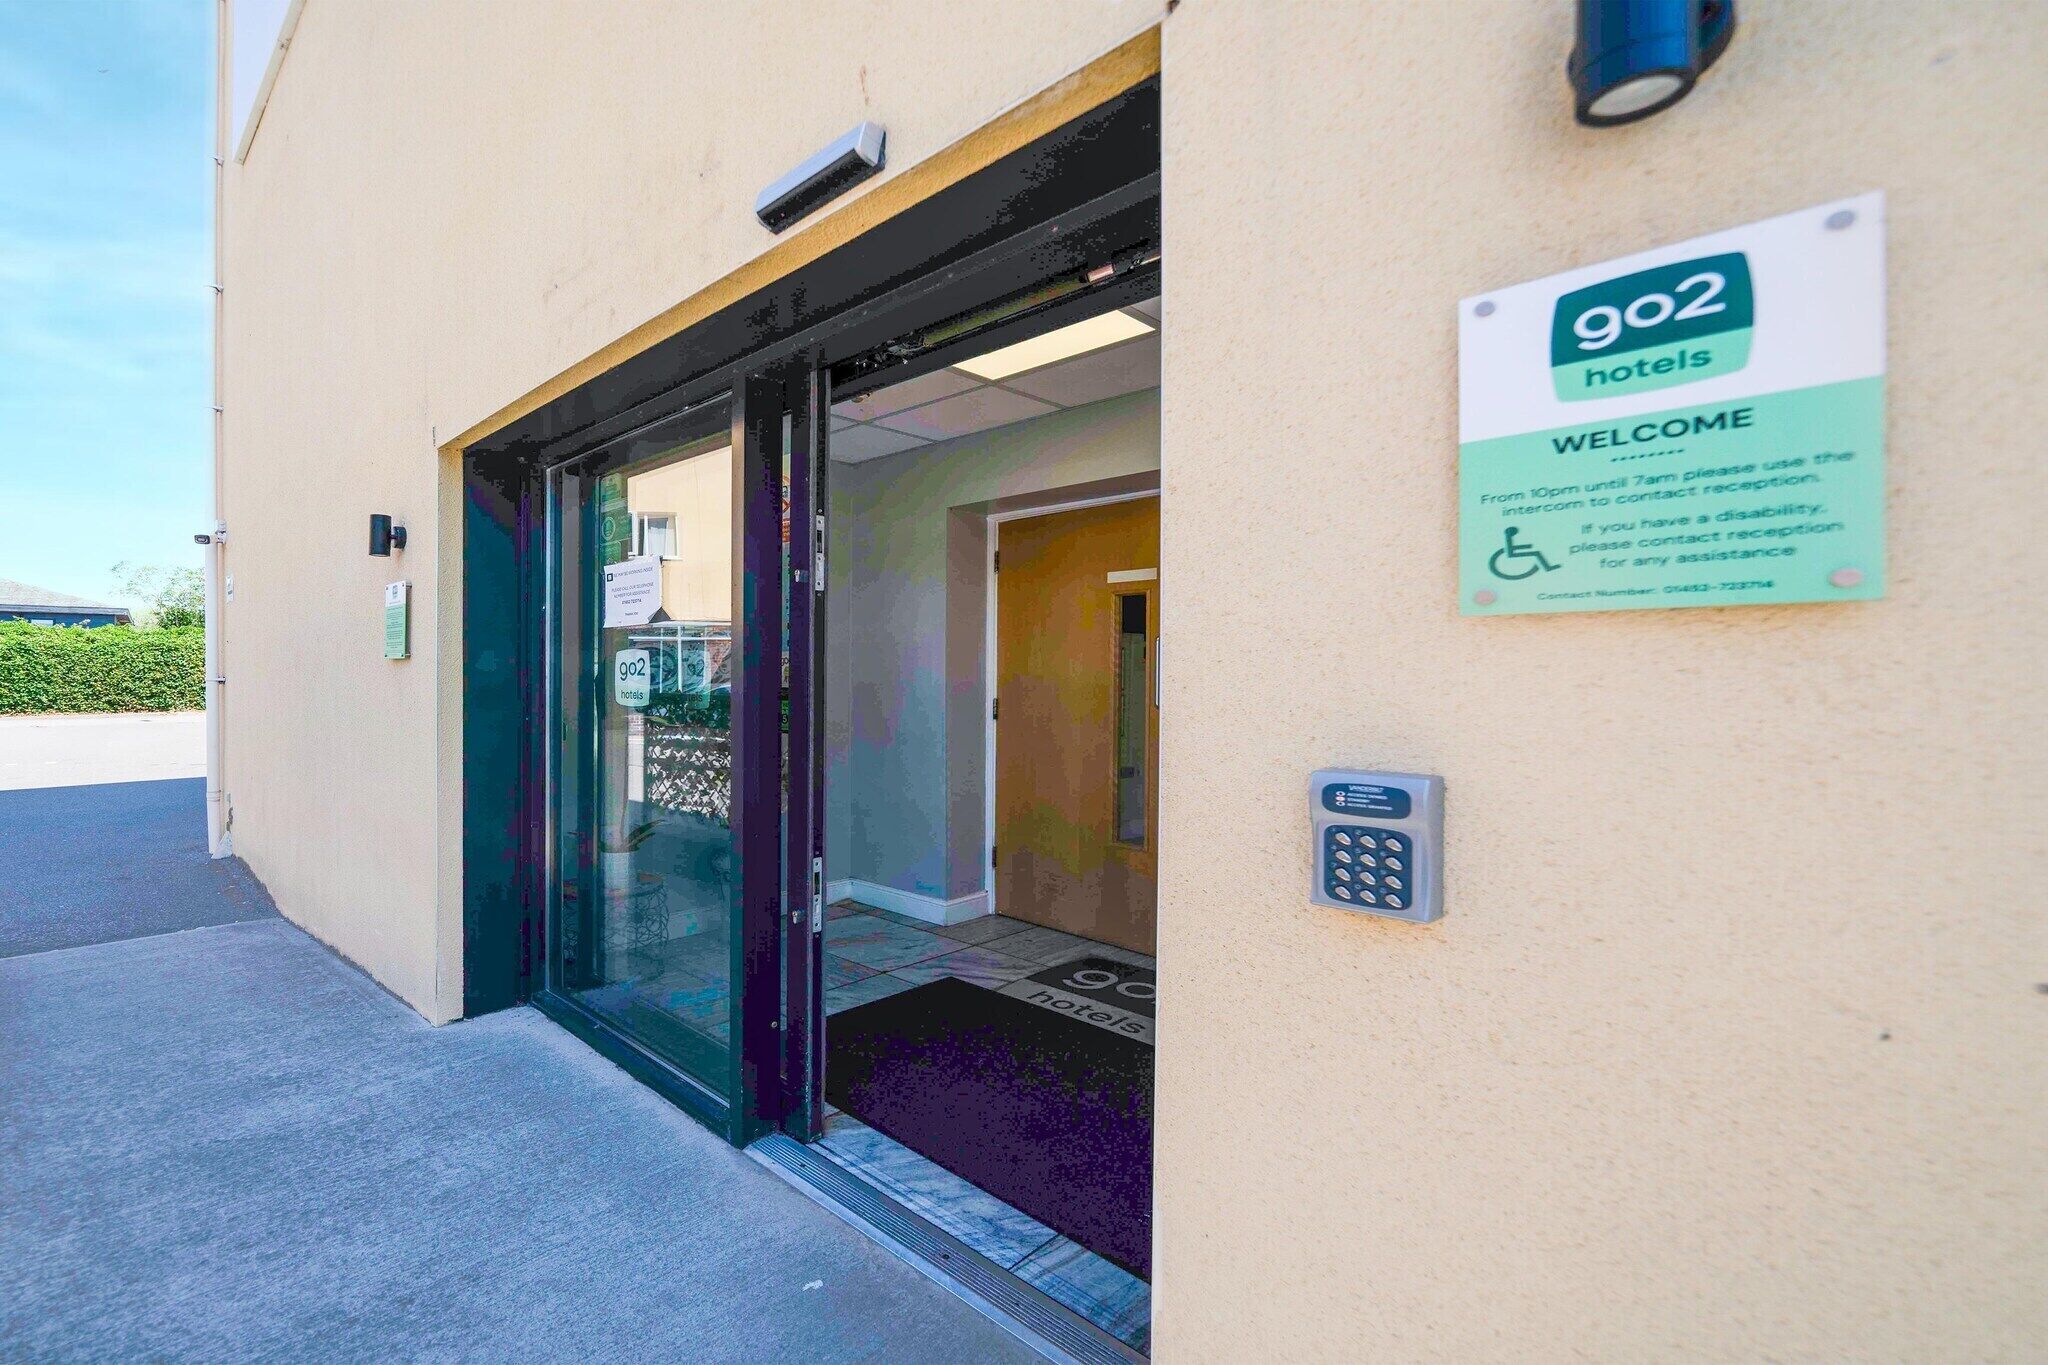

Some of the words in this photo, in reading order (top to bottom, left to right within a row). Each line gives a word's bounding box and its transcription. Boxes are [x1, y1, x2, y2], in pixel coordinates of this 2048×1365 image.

[1573, 271, 1727, 350] go2
[1584, 348, 1713, 387] hotels
[1552, 407, 1754, 455] WELCOME
[1480, 492, 1525, 504] From
[1530, 486, 1579, 499] 10pm
[1585, 476, 1628, 492] until
[1632, 473, 1677, 487] 7am
[1683, 464, 1756, 482] please
[1762, 457, 1805, 471] use
[1813, 451, 1855, 465] the
[1502, 499, 1585, 517] intercom
[1589, 497, 1610, 507] to
[1615, 487, 1697, 505] contact
[1581, 523, 1593, 534] If
[1599, 522, 1636, 536] you
[1640, 516, 1690, 529] have
[1697, 514, 1709, 524] a
[1569, 540, 1632, 555] please
[1637, 532, 1721, 548] contact
[1600, 557, 1627, 569] for
[1632, 556, 1671, 567] any
[1537, 591, 1592, 601] Contact
[619, 657, 646, 682] go2
[620, 689, 644, 701] hotels
[1062, 969, 1157, 1005] go
[1026, 990, 1146, 1035] hotels
